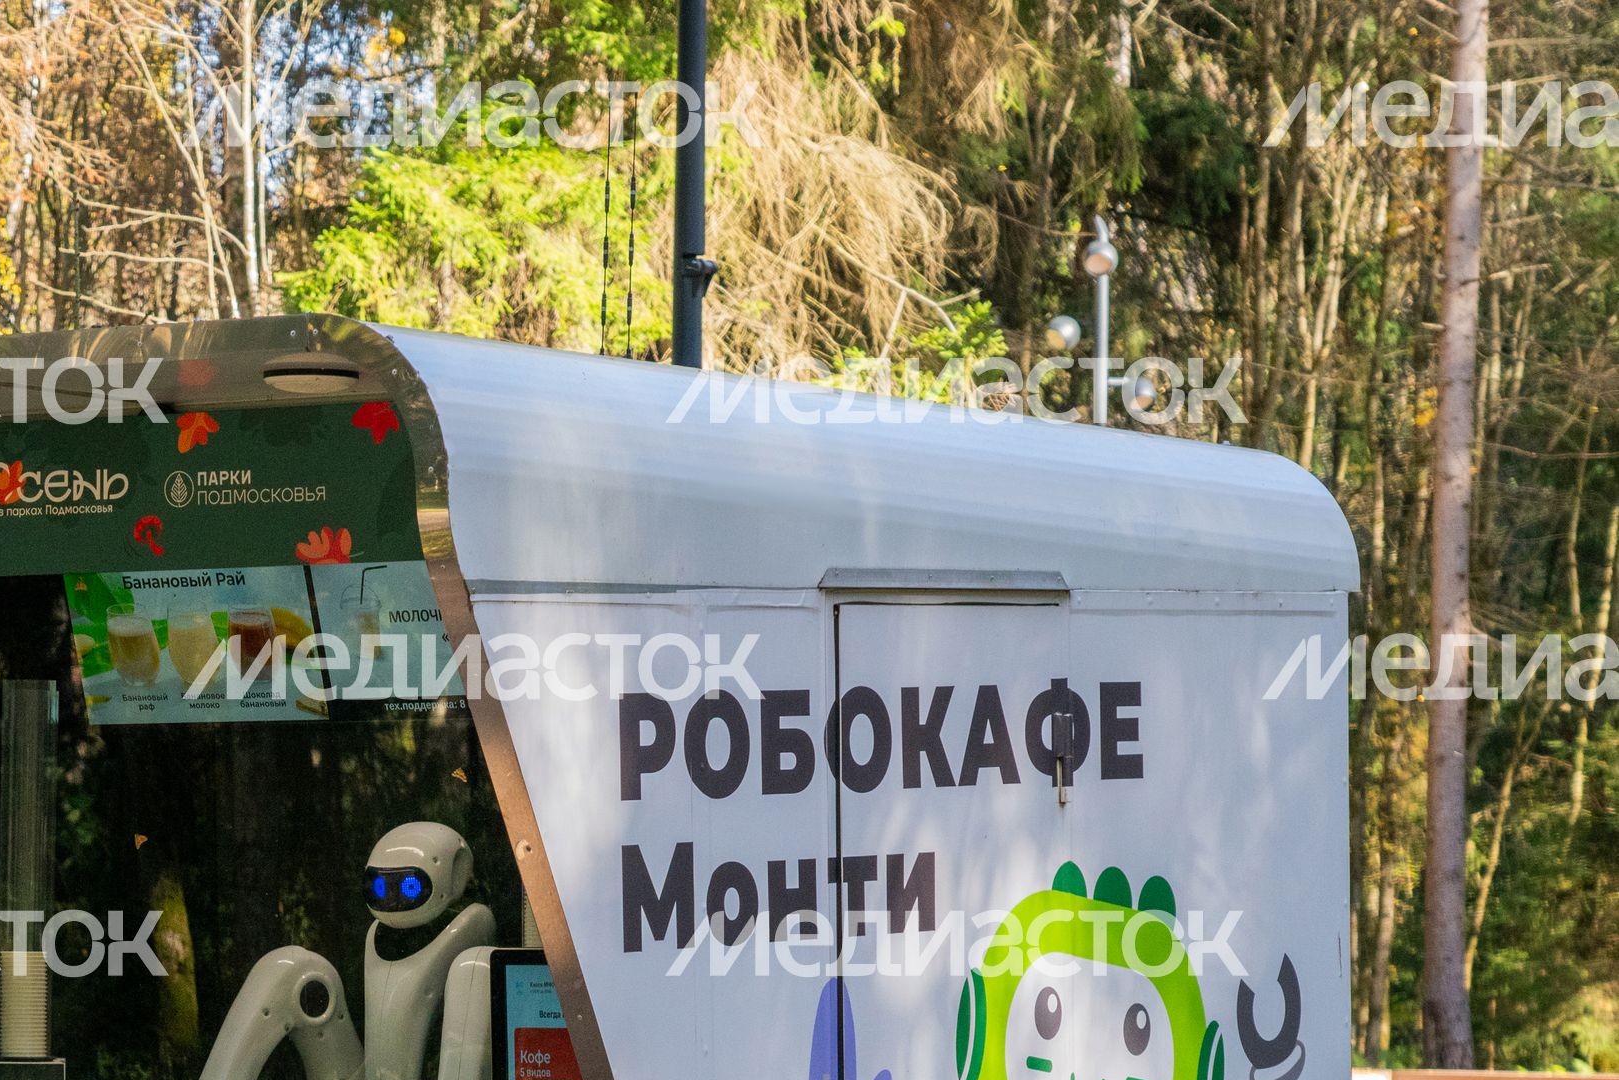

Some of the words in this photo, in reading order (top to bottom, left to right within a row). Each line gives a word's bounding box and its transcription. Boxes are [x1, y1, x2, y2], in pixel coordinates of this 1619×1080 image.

[197, 469, 252, 486] ПАРКИ
[197, 486, 326, 506] ПОДМОСКОВЬЯ
[6, 506, 43, 519] парках
[45, 503, 113, 517] Подмосковья
[122, 572, 211, 591] Банановый
[215, 571, 246, 588] Рай
[122, 692, 169, 704] Банановый
[180, 691, 226, 702] Банановое
[243, 690, 282, 701] Шоколад
[138, 702, 156, 712] раф
[189, 701, 221, 710] молоко
[239, 699, 287, 710] банановый
[619, 677, 1144, 801] РОБОКАФЕ
[621, 841, 937, 954] Монти
[539, 1010, 561, 1019] Всегда
[519, 1049, 551, 1068] Кофе
[520, 1067, 526, 1078] 5
[526, 1068, 551, 1078] видов
